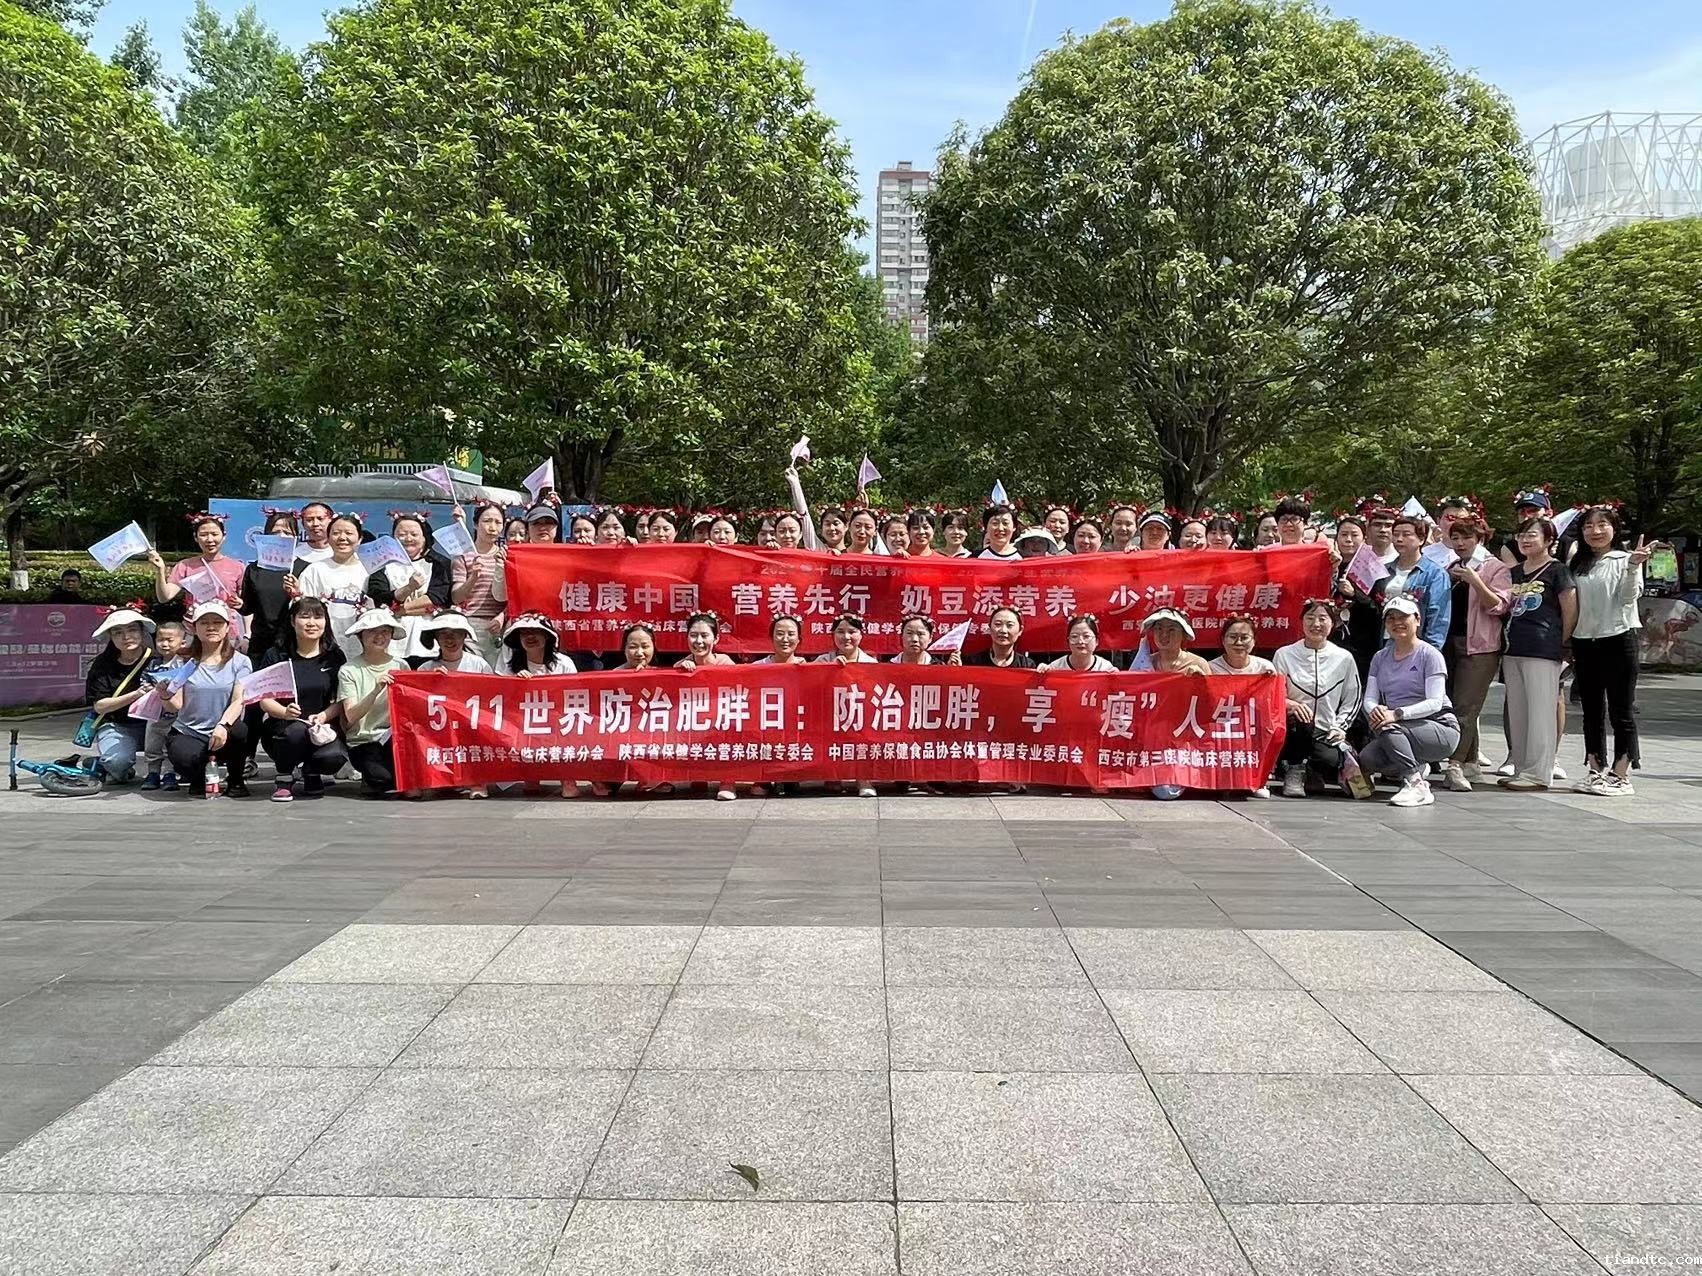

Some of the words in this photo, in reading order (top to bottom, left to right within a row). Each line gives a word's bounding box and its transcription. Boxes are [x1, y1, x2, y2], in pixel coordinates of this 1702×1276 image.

[558, 581, 700, 614] 健康中国
[731, 584, 871, 615] 营养先行
[901, 584, 1078, 616] 奶豆添营养
[1108, 582, 1283, 616] 少油更健康
[427, 694, 504, 731] 5.11
[426, 745, 605, 766] 陕西省营养学会临床营养分会
[618, 742, 815, 763] 陕西省保健学会营养保健专委会
[828, 741, 1085, 766] 中国营养保健食品协会体重管理专业委员会
[1097, 747, 1260, 769] 西安市第三医院临床营养科
